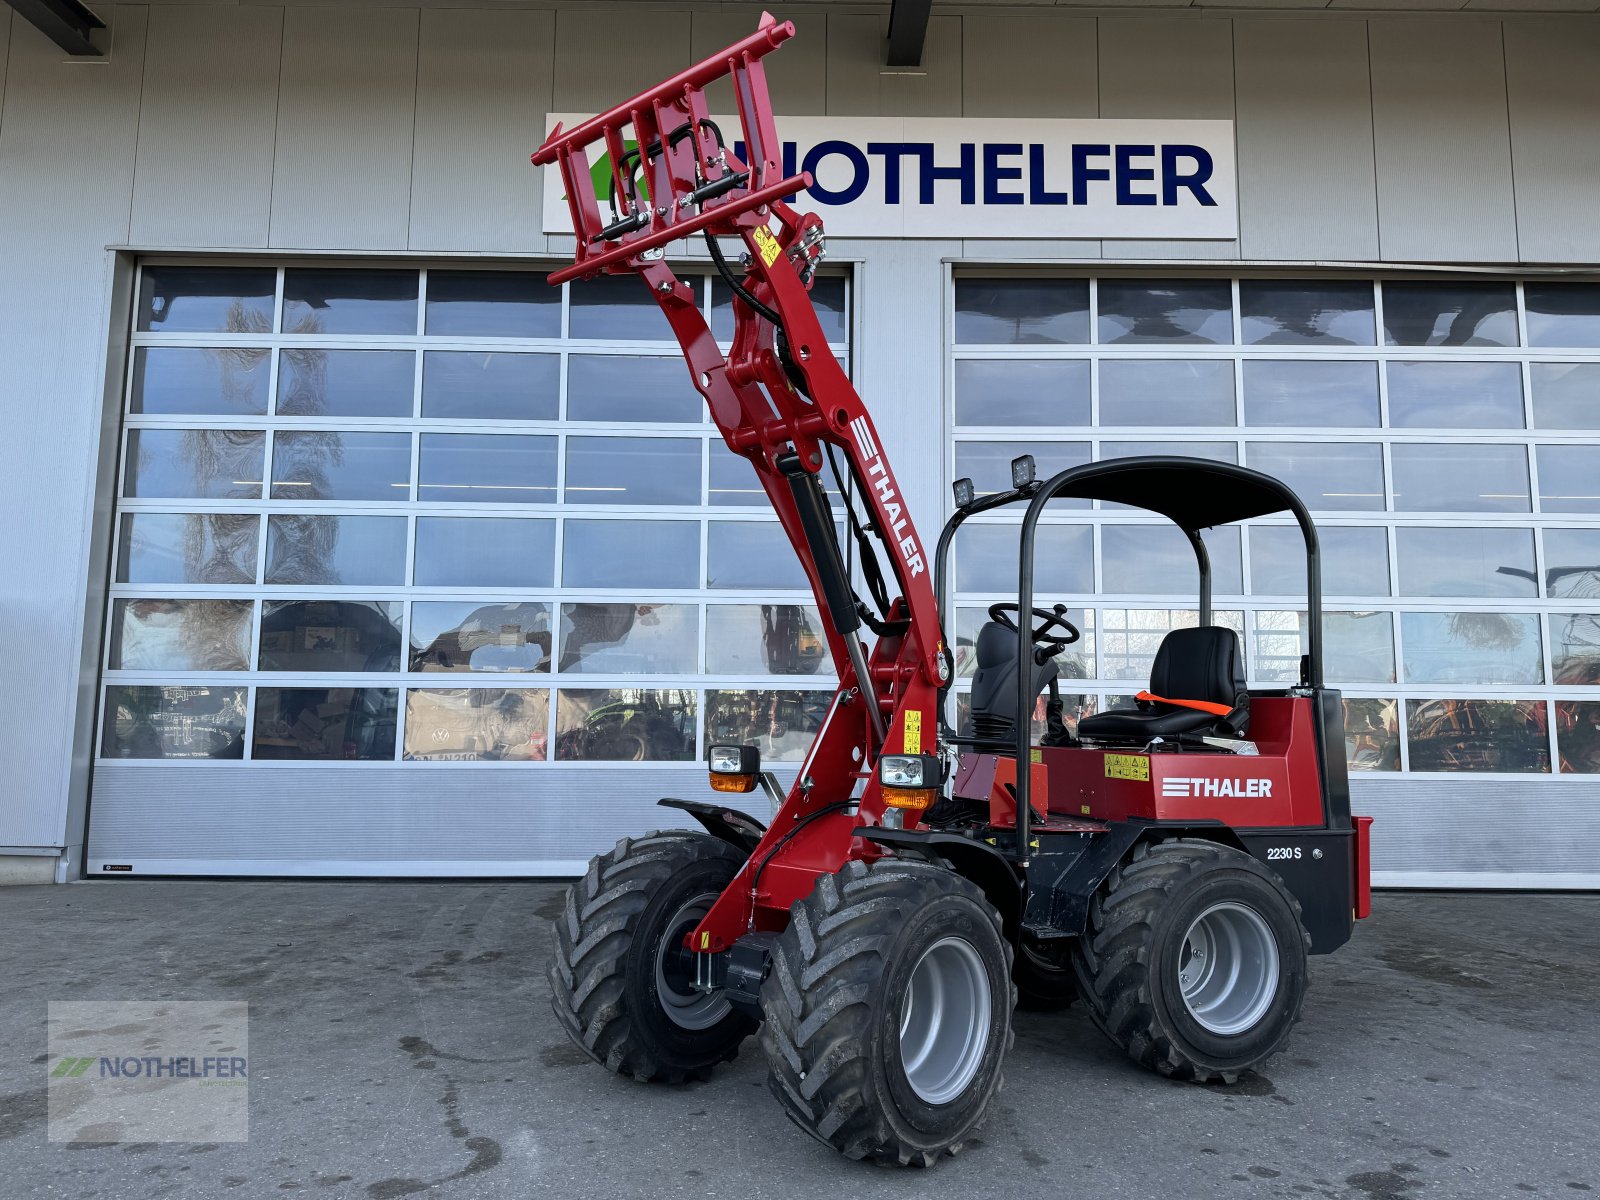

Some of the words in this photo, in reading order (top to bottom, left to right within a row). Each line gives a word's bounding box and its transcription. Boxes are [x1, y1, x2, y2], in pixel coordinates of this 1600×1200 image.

[1191, 778, 1271, 797] THALER
[1267, 847, 1293, 860] 2230
[1294, 847, 1302, 860] S
